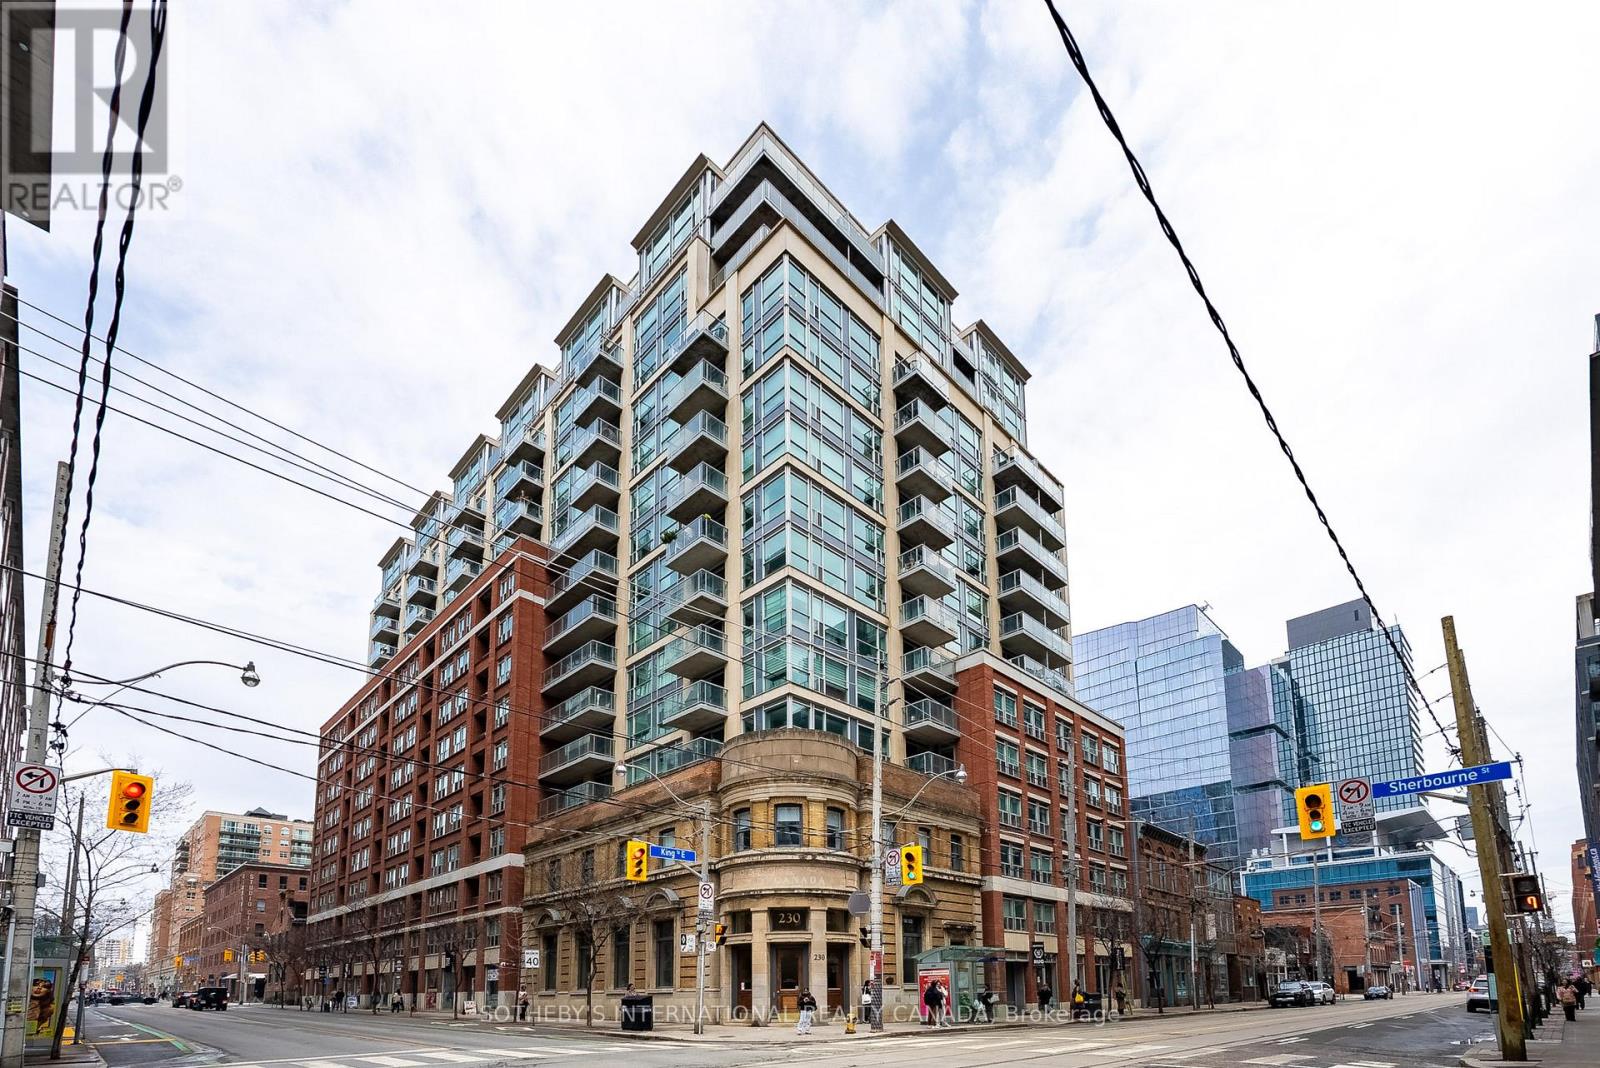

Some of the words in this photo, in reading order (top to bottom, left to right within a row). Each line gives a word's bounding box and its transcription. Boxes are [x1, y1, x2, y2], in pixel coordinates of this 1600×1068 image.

[1389, 771, 1478, 793] Sherbourne
[25, 814, 54, 823] VEHICLES
[10, 819, 51, 829] EXCEPTED
[1344, 824, 1374, 833] EXCEPTED
[660, 848, 676, 860] King
[681, 851, 686, 859] E
[778, 912, 801, 924] 230
[525, 957, 539, 966] 40
[813, 953, 826, 961] 230
